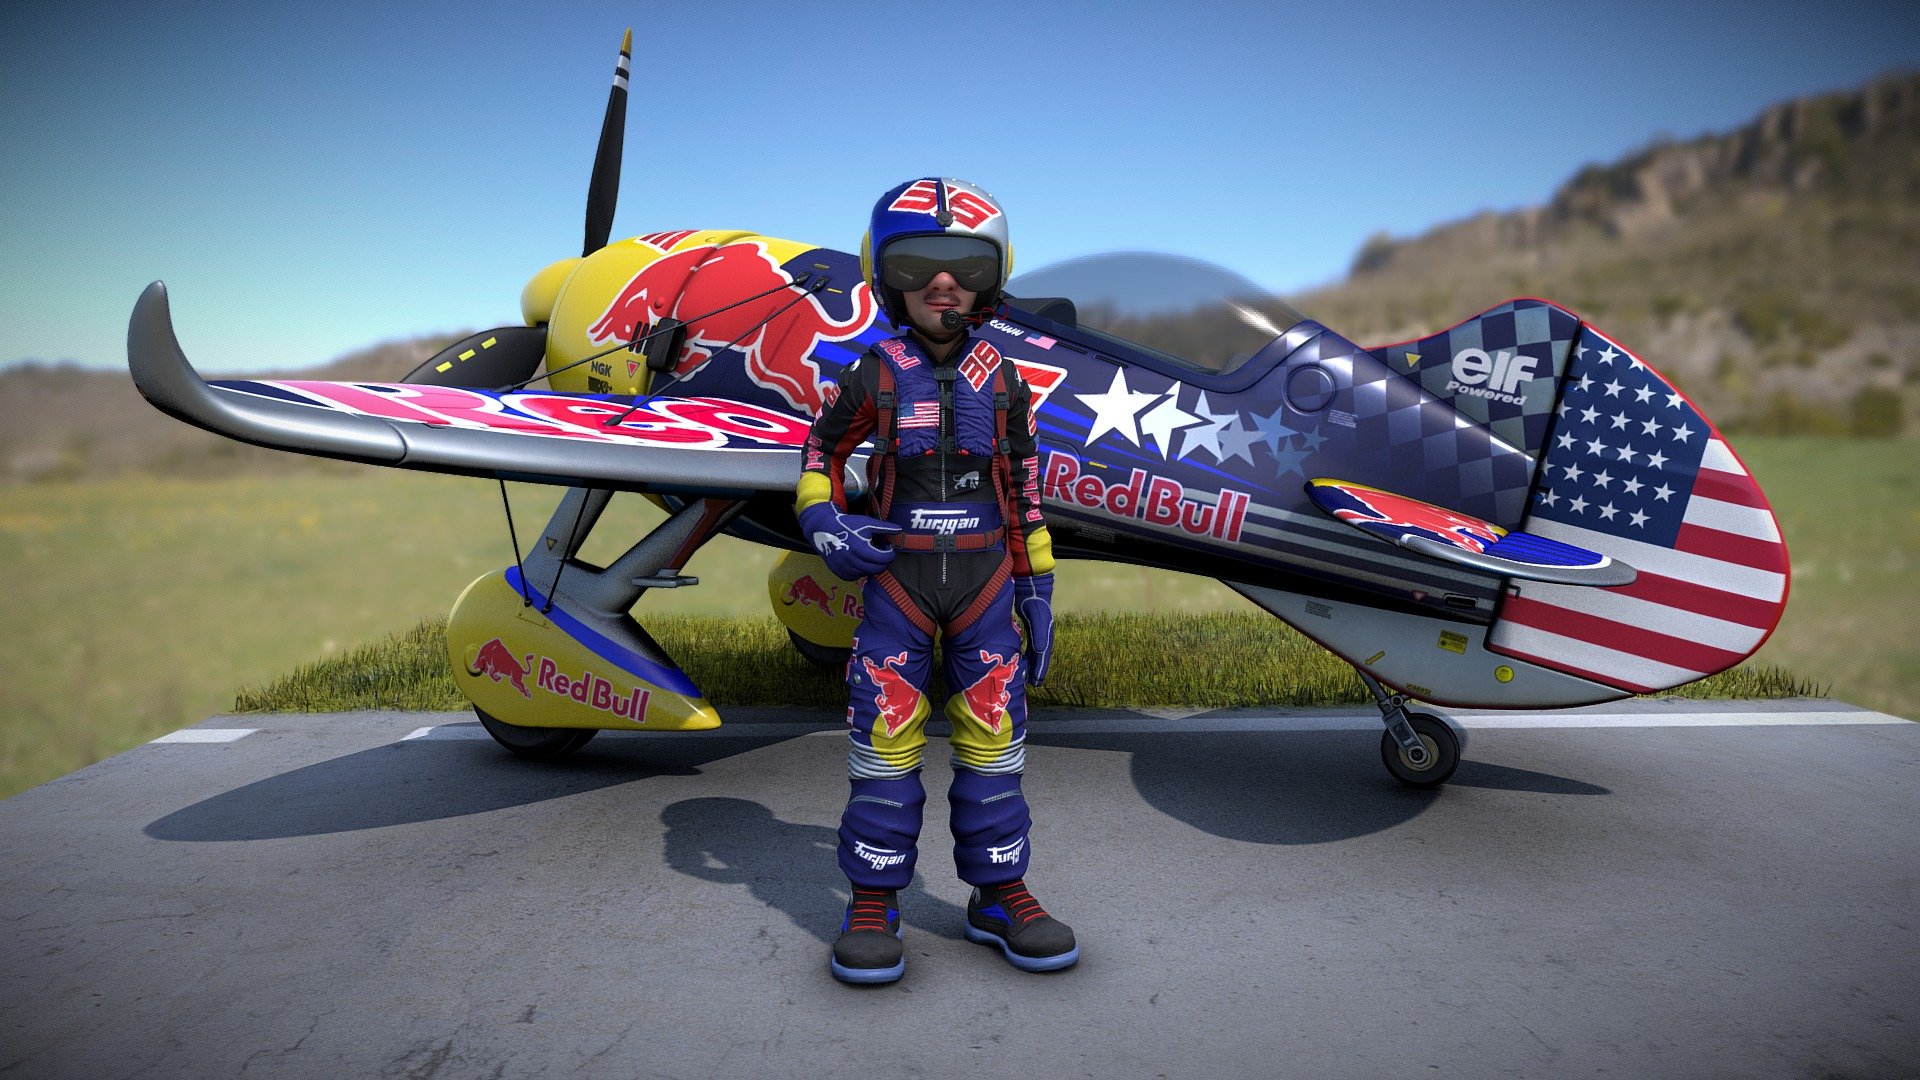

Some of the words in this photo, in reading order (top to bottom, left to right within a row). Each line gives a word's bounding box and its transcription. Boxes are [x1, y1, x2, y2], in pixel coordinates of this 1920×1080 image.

[591, 361, 612, 377] NGK
[884, 342, 921, 370] Bull
[958, 340, 1001, 392] 36
[1452, 348, 1538, 394] elf
[1446, 380, 1528, 406] Powered
[1022, 456, 1039, 490] Bull
[1043, 450, 1147, 519] Red
[1144, 475, 1250, 544] Bull
[911, 509, 980, 535] Furygan
[843, 593, 865, 620] Re
[538, 656, 592, 704] Red
[591, 677, 651, 723] Bull
[855, 841, 906, 870] Furygan
